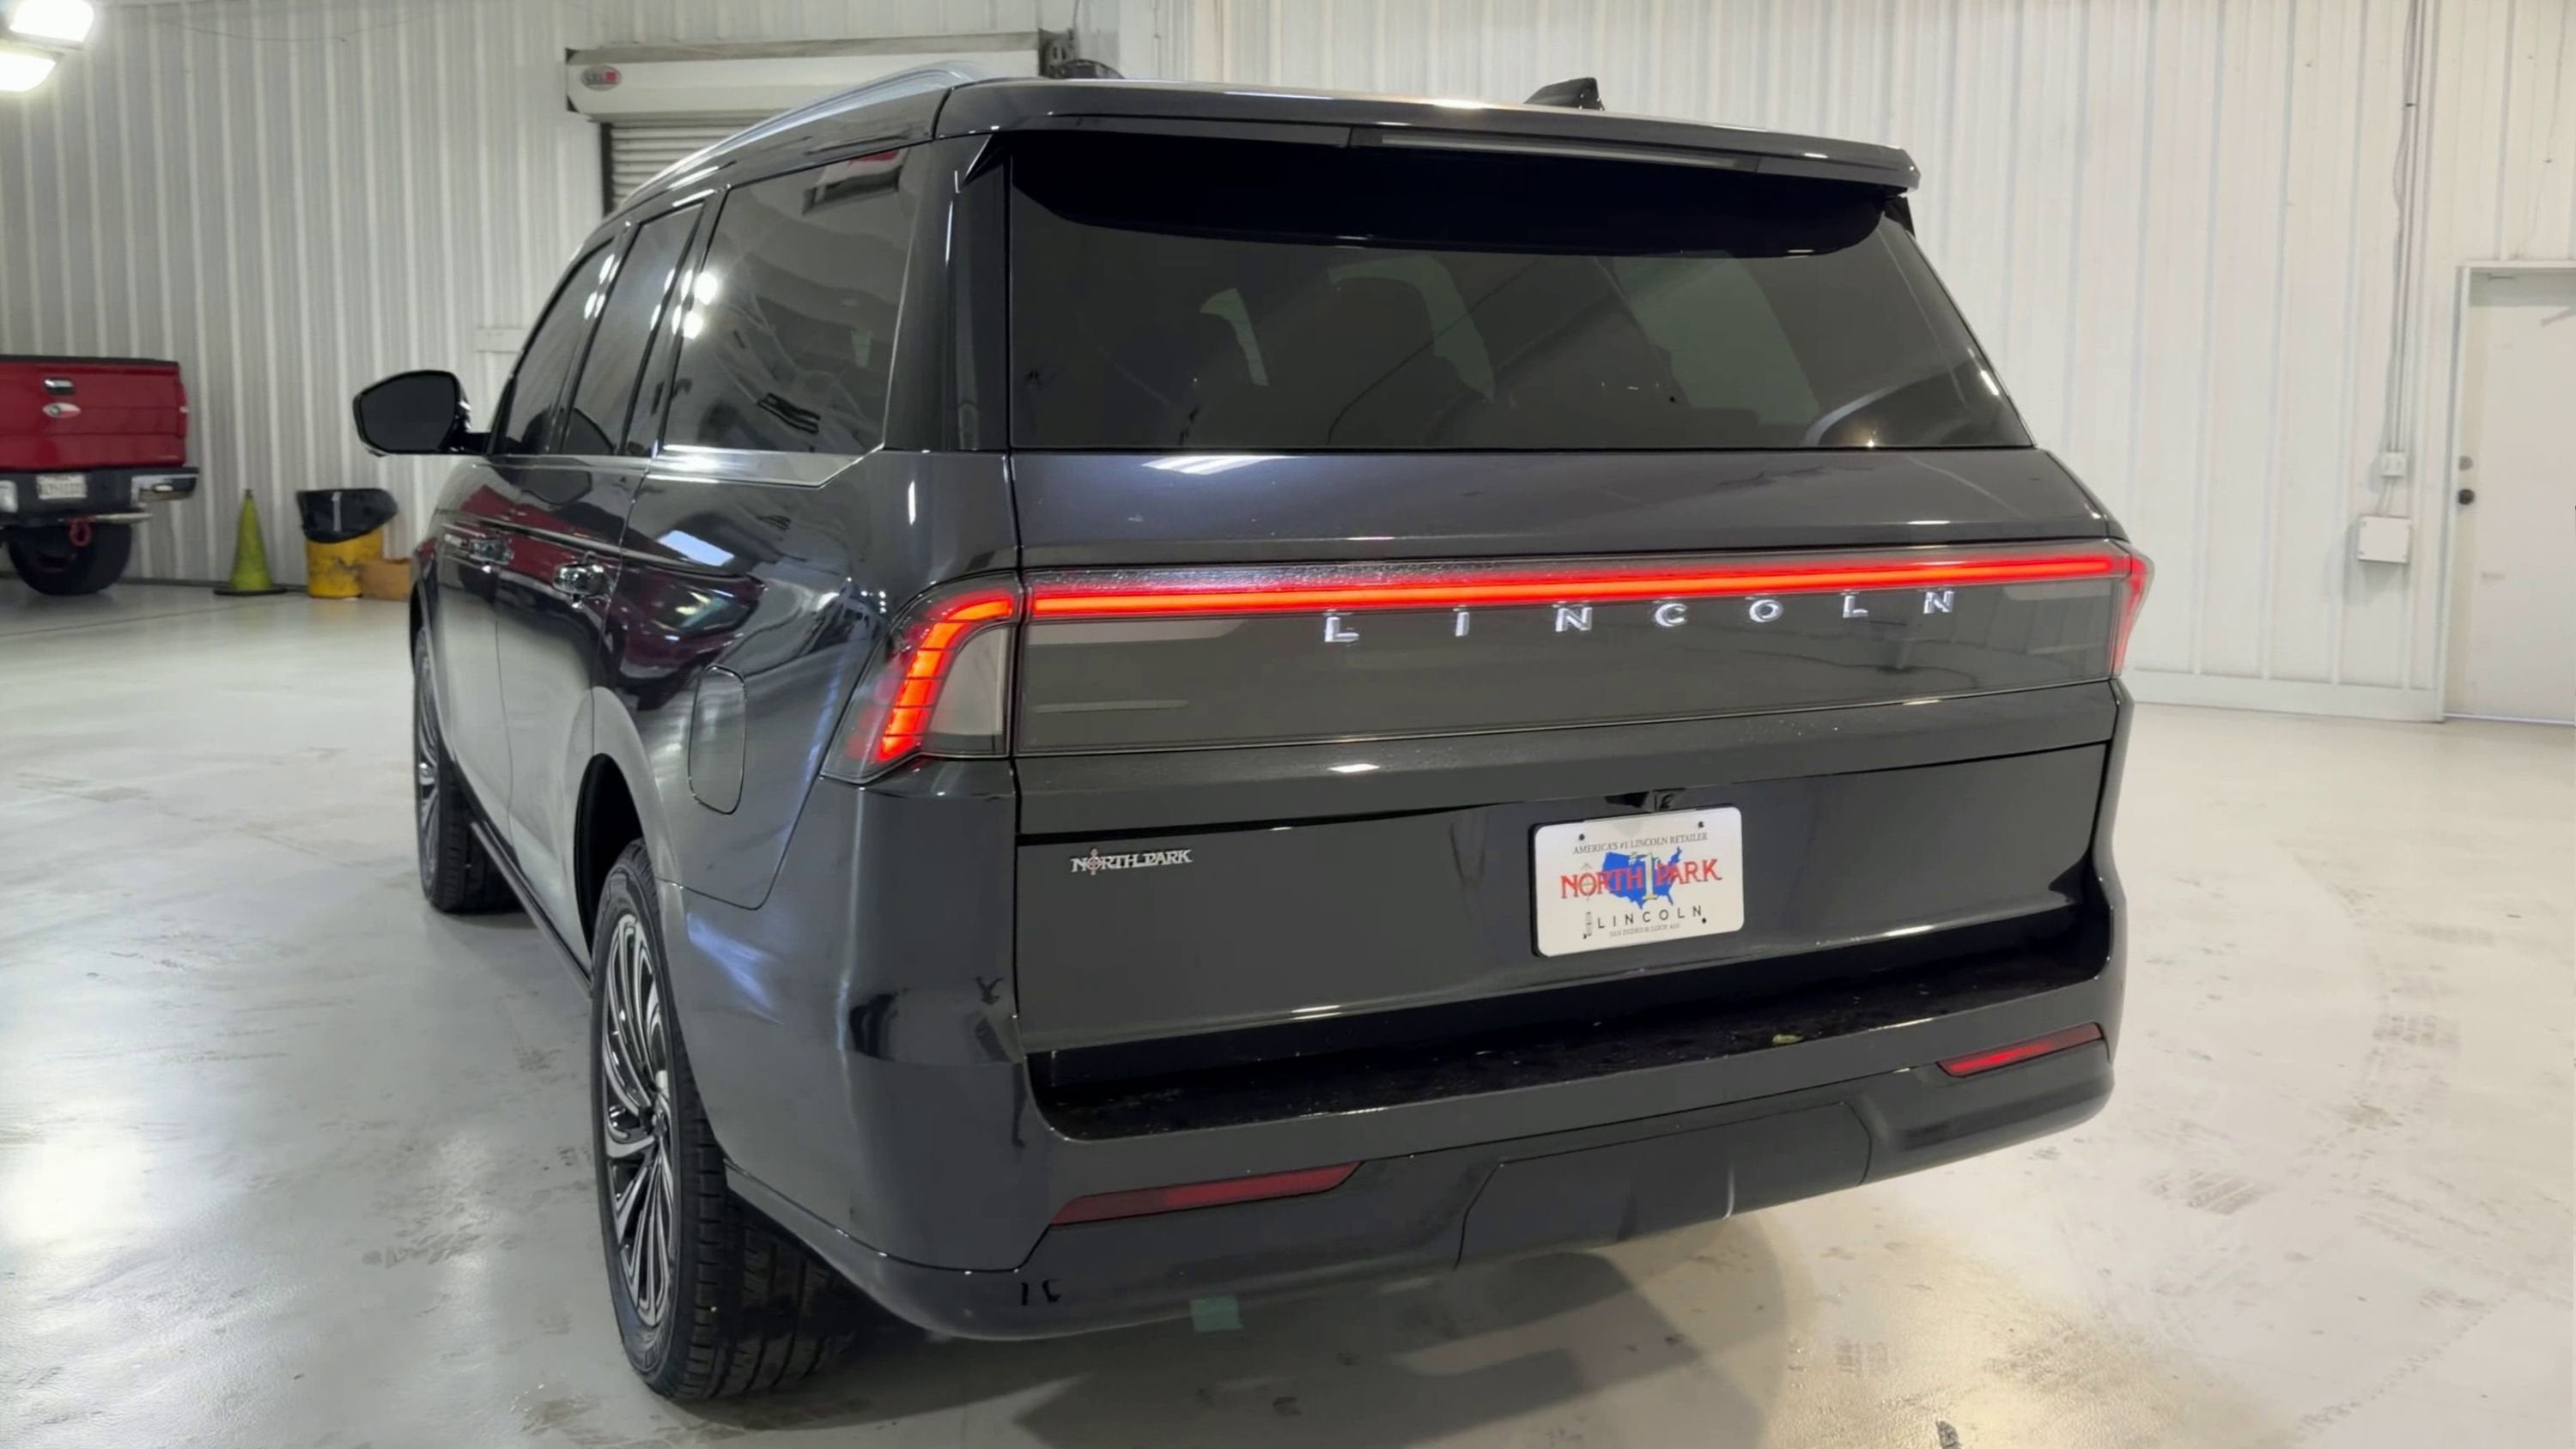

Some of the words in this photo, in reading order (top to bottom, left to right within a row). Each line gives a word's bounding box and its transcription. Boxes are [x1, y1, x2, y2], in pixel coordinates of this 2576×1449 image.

[1323, 590, 1955, 642] LINCOLN
[1573, 842, 1619, 854] AMERICA'S
[1631, 837, 1668, 848] LINCOLN
[1670, 833, 1708, 844] RETAILER
[1070, 852, 1140, 873] NORTH
[1142, 849, 1194, 866] PARK
[1560, 866, 1643, 899] NORTH
[1656, 858, 1722, 887] PARK
[1597, 906, 1702, 929] LINCOLN
